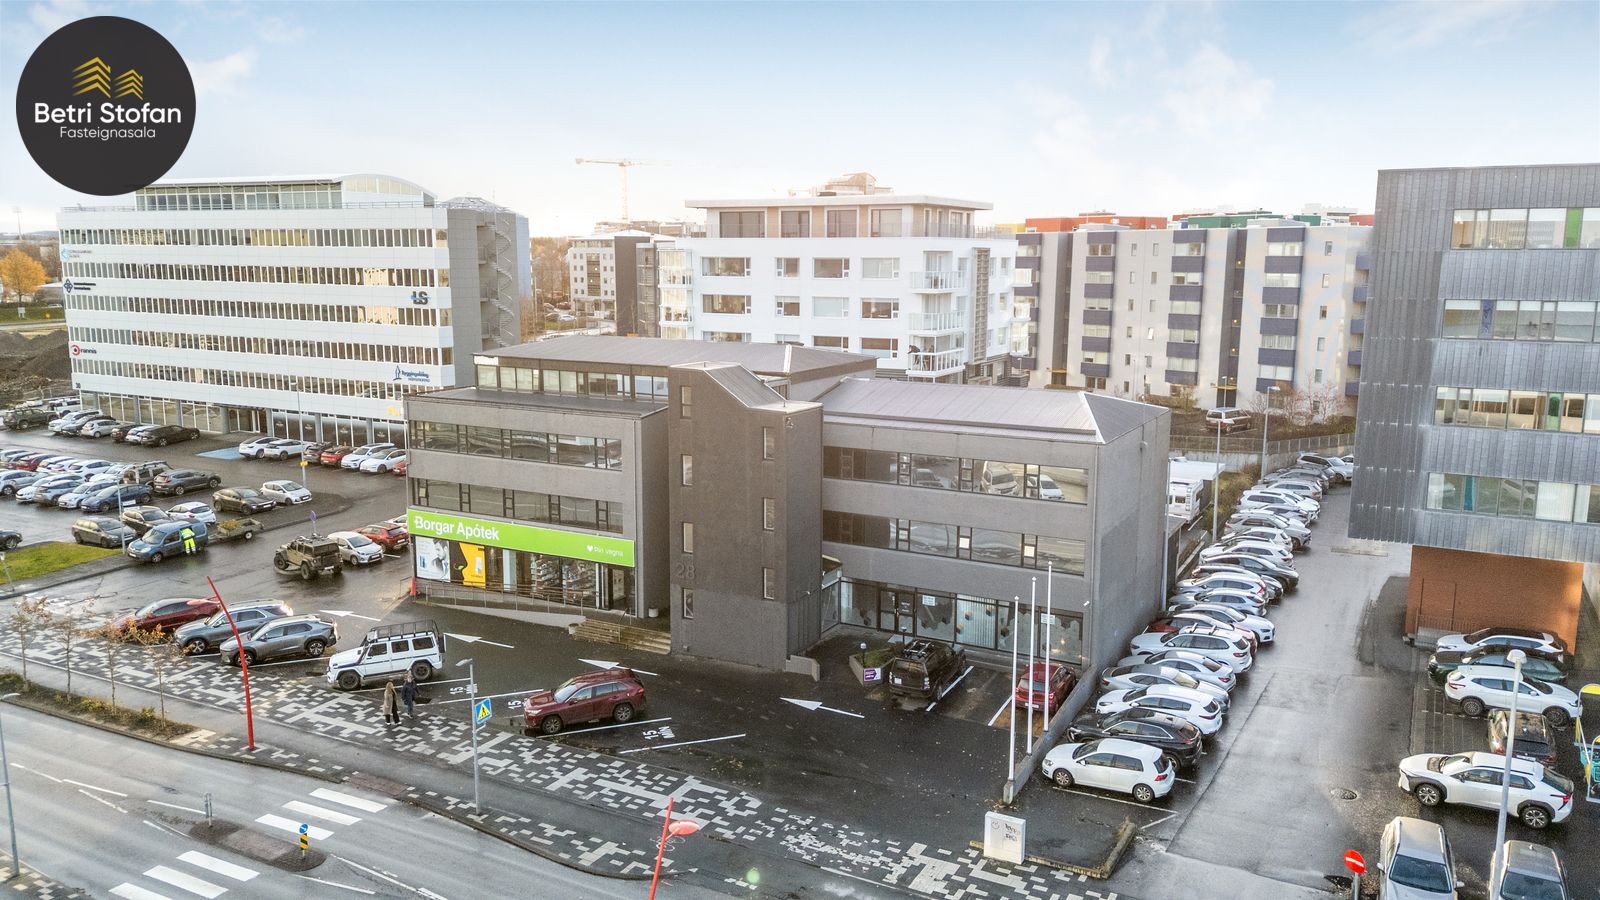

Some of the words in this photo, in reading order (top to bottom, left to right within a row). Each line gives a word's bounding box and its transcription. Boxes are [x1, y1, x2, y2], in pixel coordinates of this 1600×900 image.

[414, 515, 455, 535] Borgar
[456, 521, 500, 540] Apótek
[675, 562, 695, 580] 28
[508, 700, 521, 710] 15
[642, 730, 659, 739] 15
